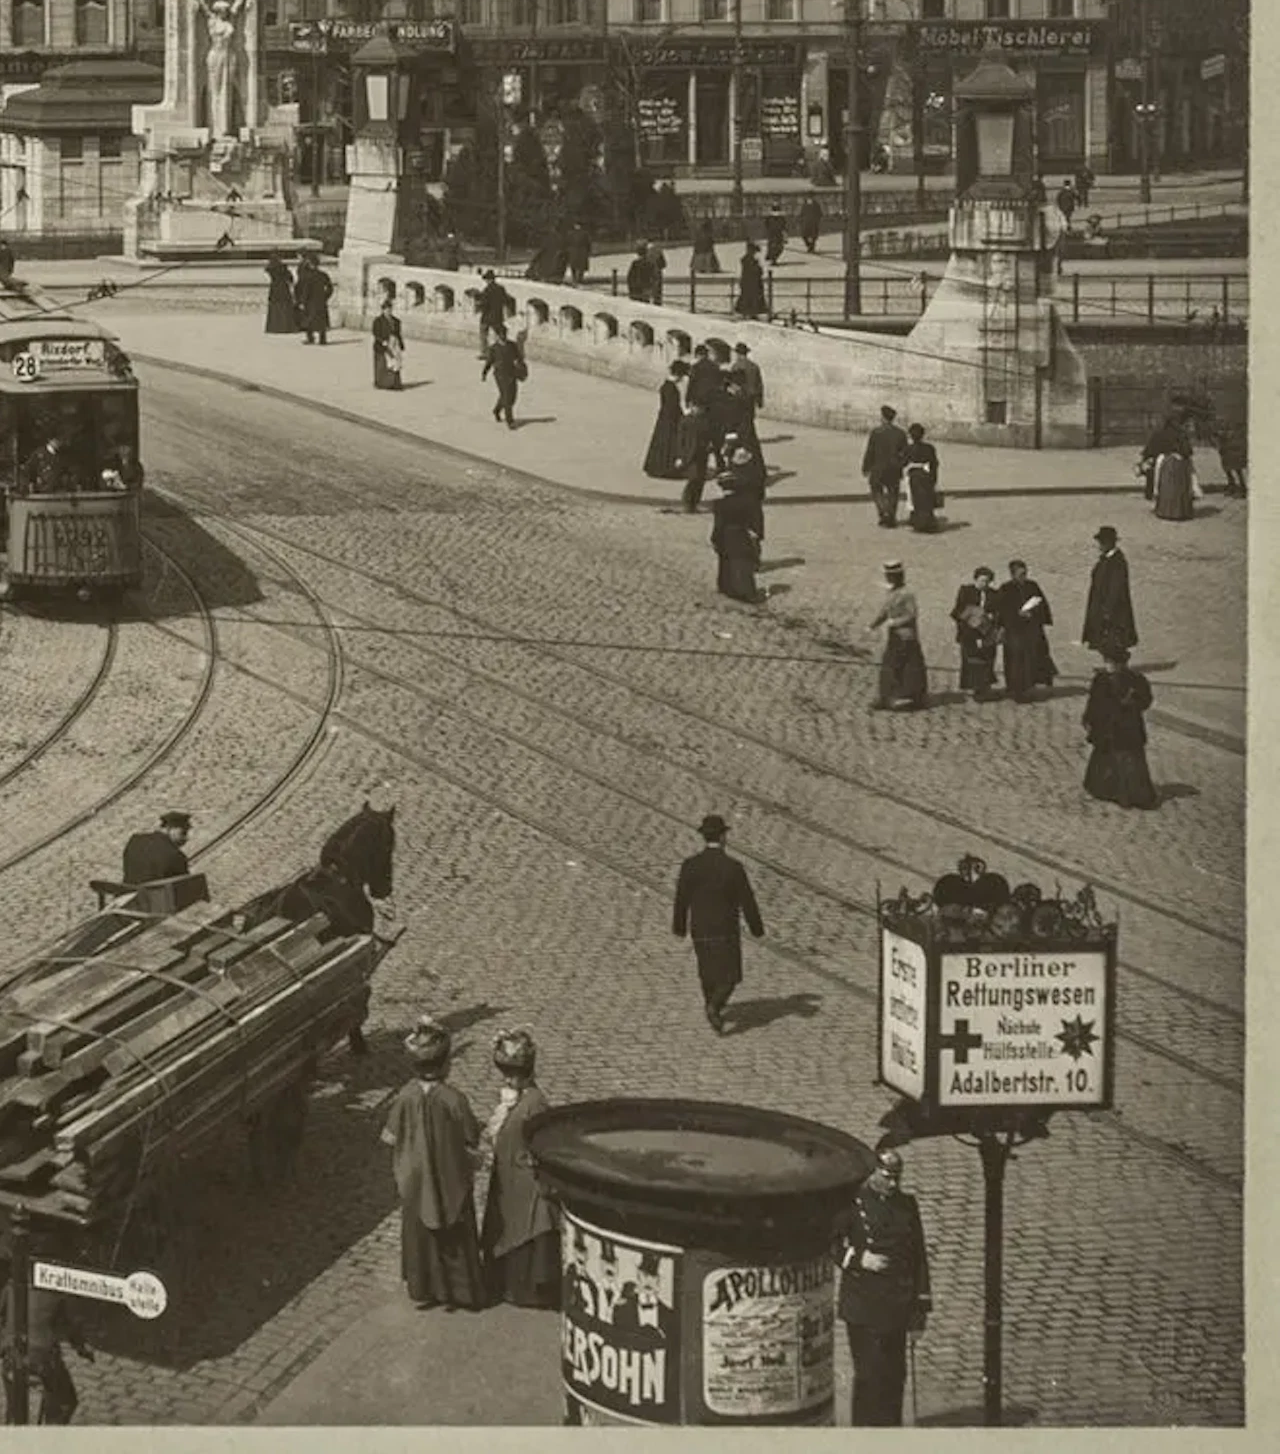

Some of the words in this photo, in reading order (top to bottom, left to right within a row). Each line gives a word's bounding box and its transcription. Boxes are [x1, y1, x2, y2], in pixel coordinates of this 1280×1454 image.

[15, 356, 36, 377] 28
[965, 957, 1077, 979] Berliner
[946, 980, 1095, 1011] Rettungswesen
[950, 1070, 1060, 1095] Adalbertstr.
